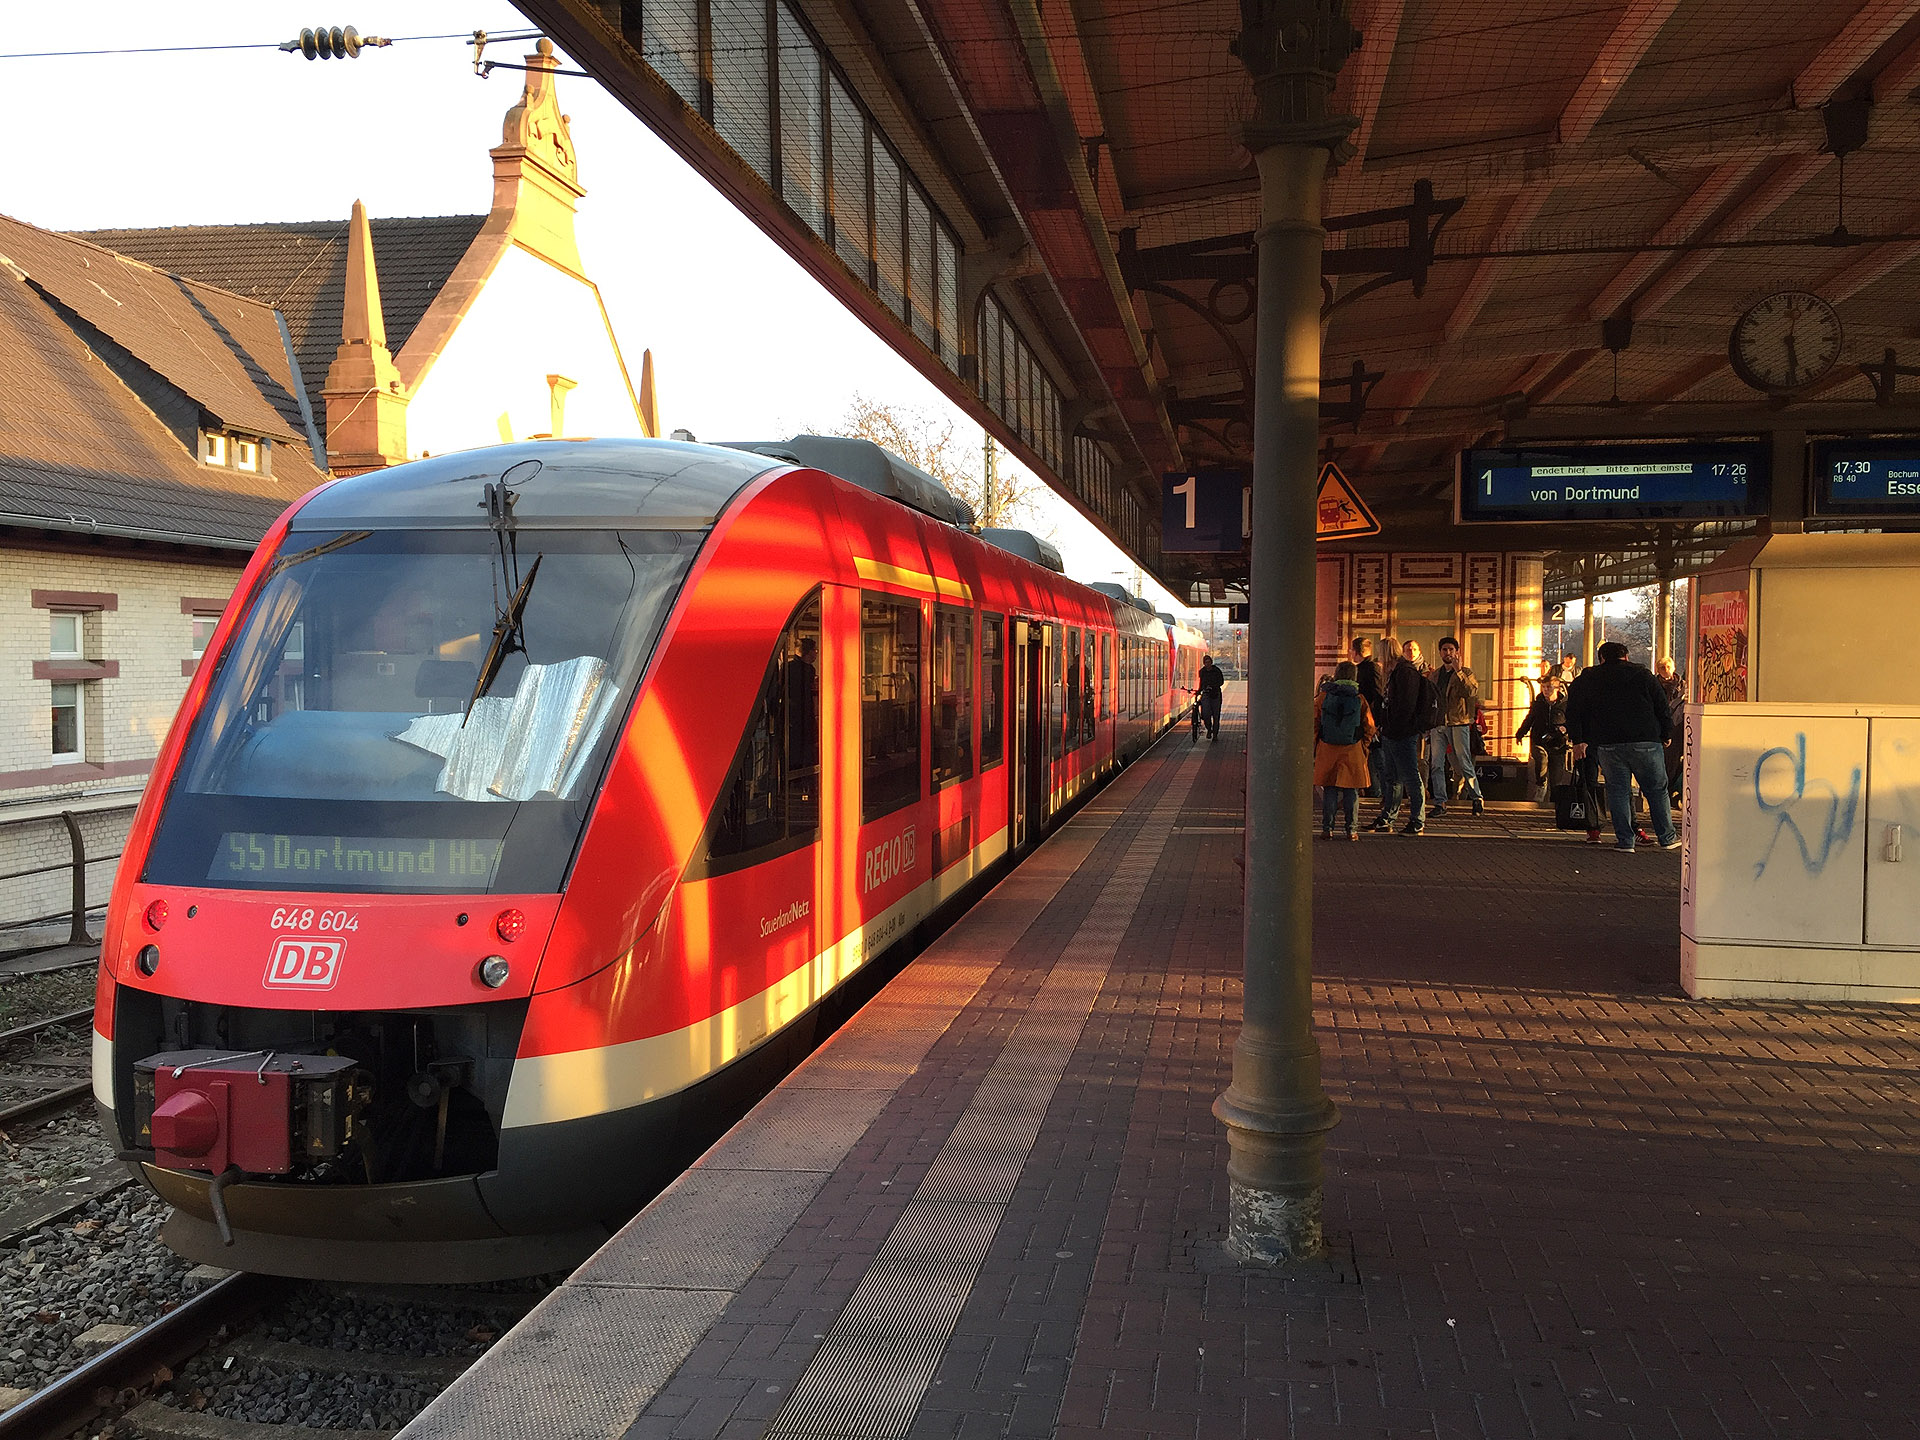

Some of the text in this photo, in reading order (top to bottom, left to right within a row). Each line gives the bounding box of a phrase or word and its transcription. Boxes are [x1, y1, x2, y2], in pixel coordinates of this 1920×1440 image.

[1536, 466, 1565, 475] endet
[1632, 464, 1657, 473] nicht
[1711, 463, 1747, 476] 17:26
[1834, 461, 1871, 474] 17:30
[1888, 470, 1919, 479] Bochum
[1480, 468, 1494, 495] 1
[1733, 476, 1747, 485] S 5
[1833, 474, 1857, 483] RB 40
[1530, 485, 1640, 501] von Dortmund
[1172, 476, 1196, 529] 1
[1230, 604, 1239, 620] 1
[1551, 603, 1564, 621] 2
[272, 834, 436, 874] Dortmund
[864, 828, 915, 894] REGIO DB
[270, 907, 360, 932] 648 604
[759, 900, 810, 938] SauerlandNetz
[269, 940, 341, 985] DB
